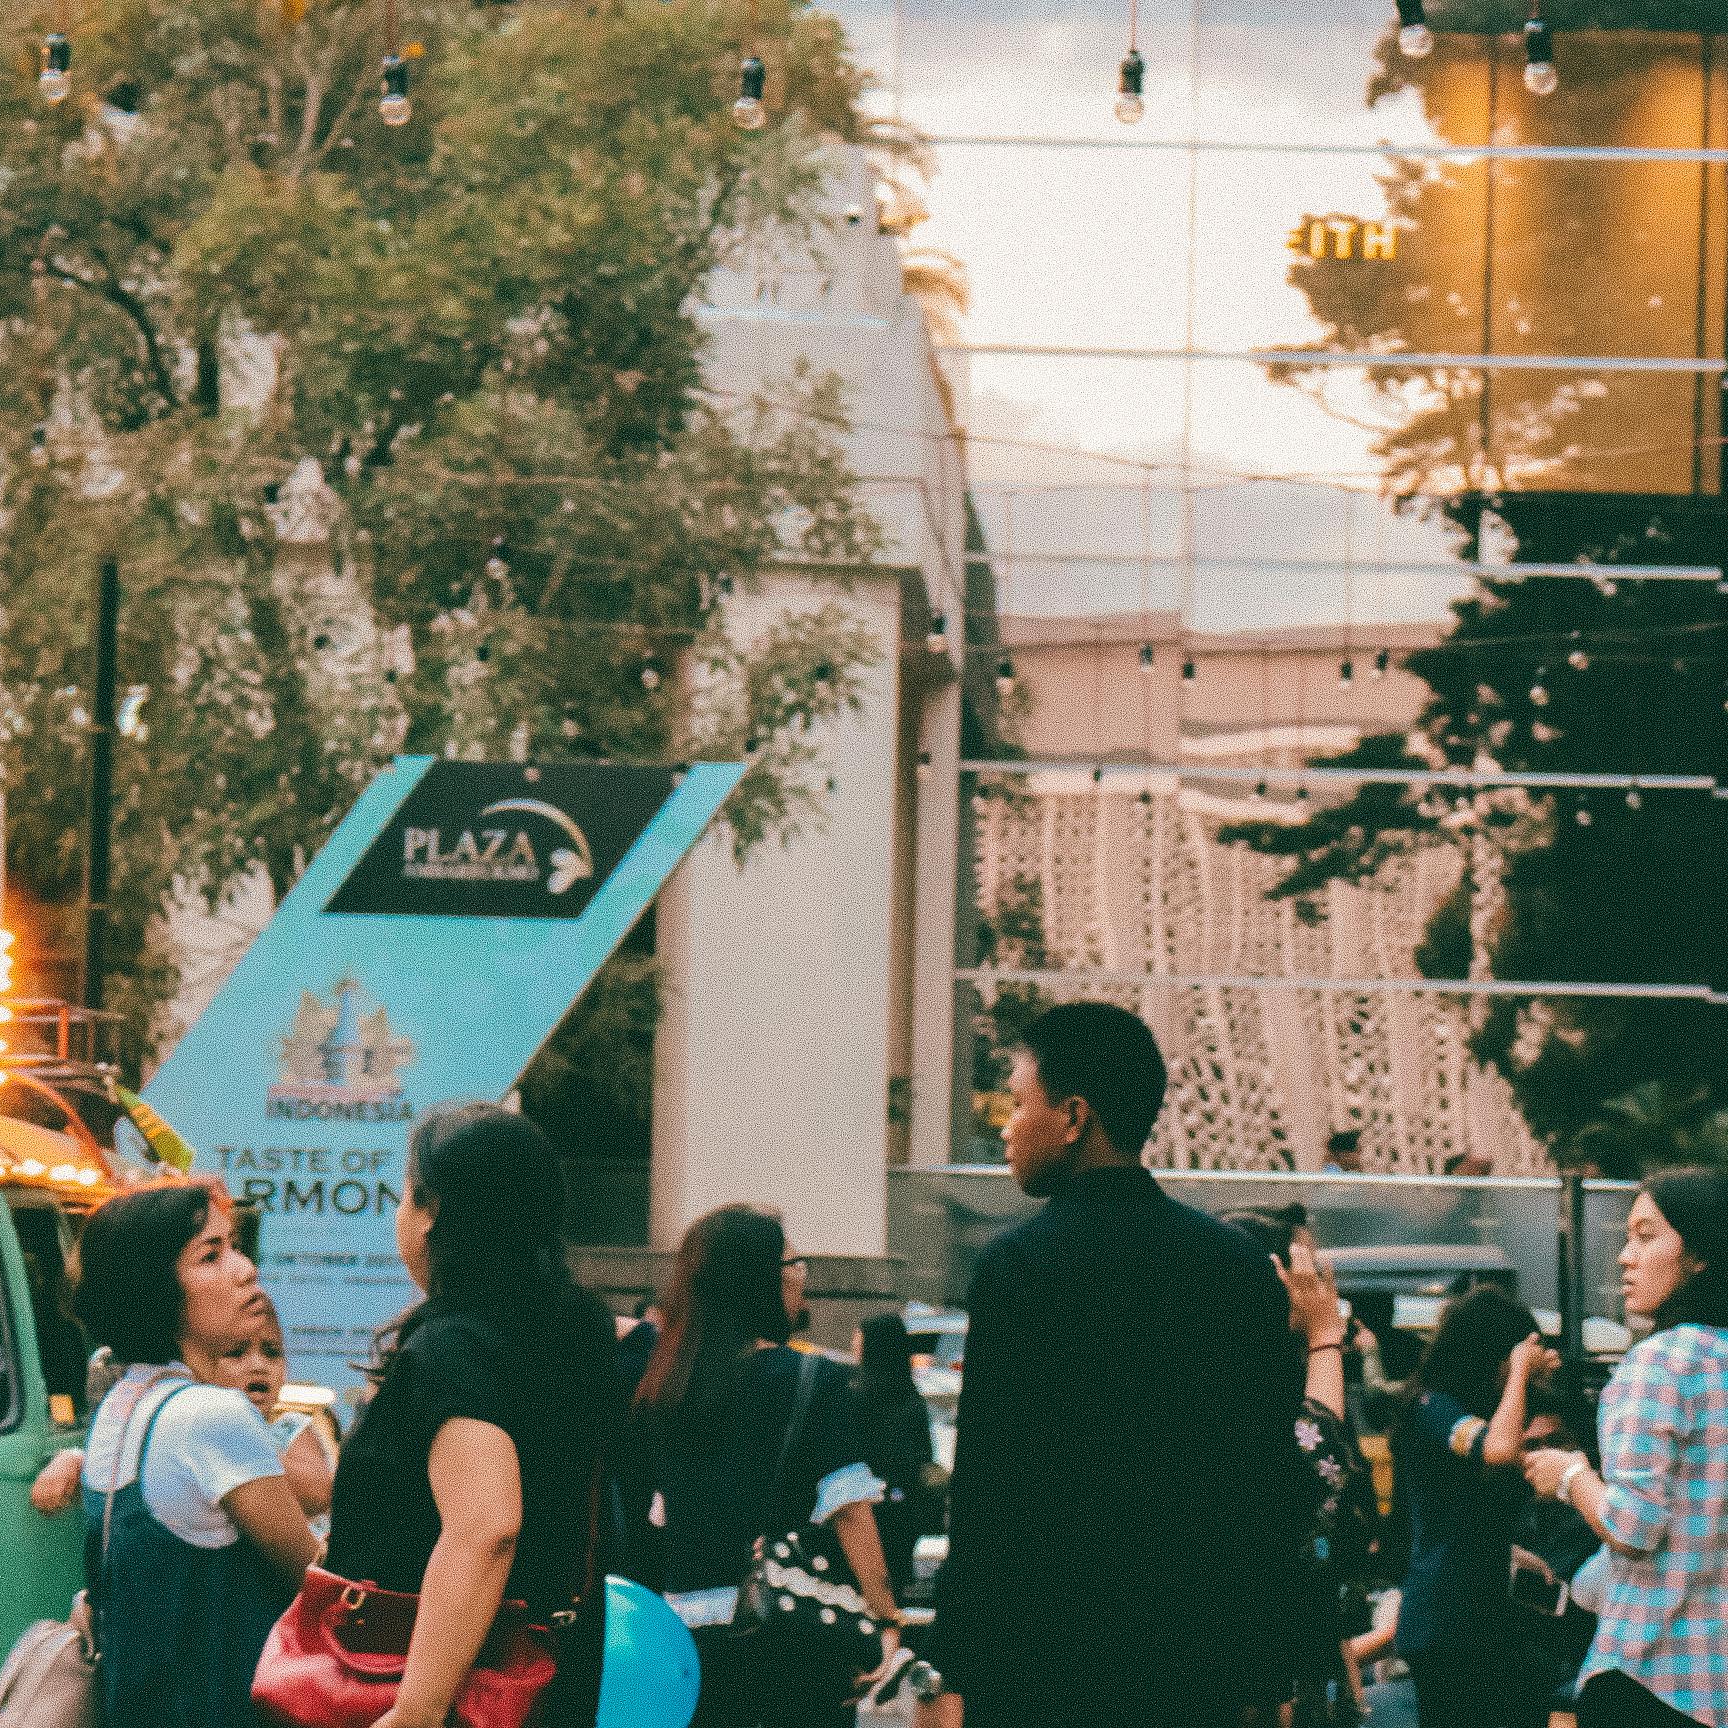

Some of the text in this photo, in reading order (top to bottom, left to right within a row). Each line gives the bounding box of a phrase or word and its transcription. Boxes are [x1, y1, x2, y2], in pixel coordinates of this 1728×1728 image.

[403, 827, 537, 864] PLAZA
[266, 1100, 413, 1120] INDONESIA
[215, 1146, 391, 1173] TASTE OF
